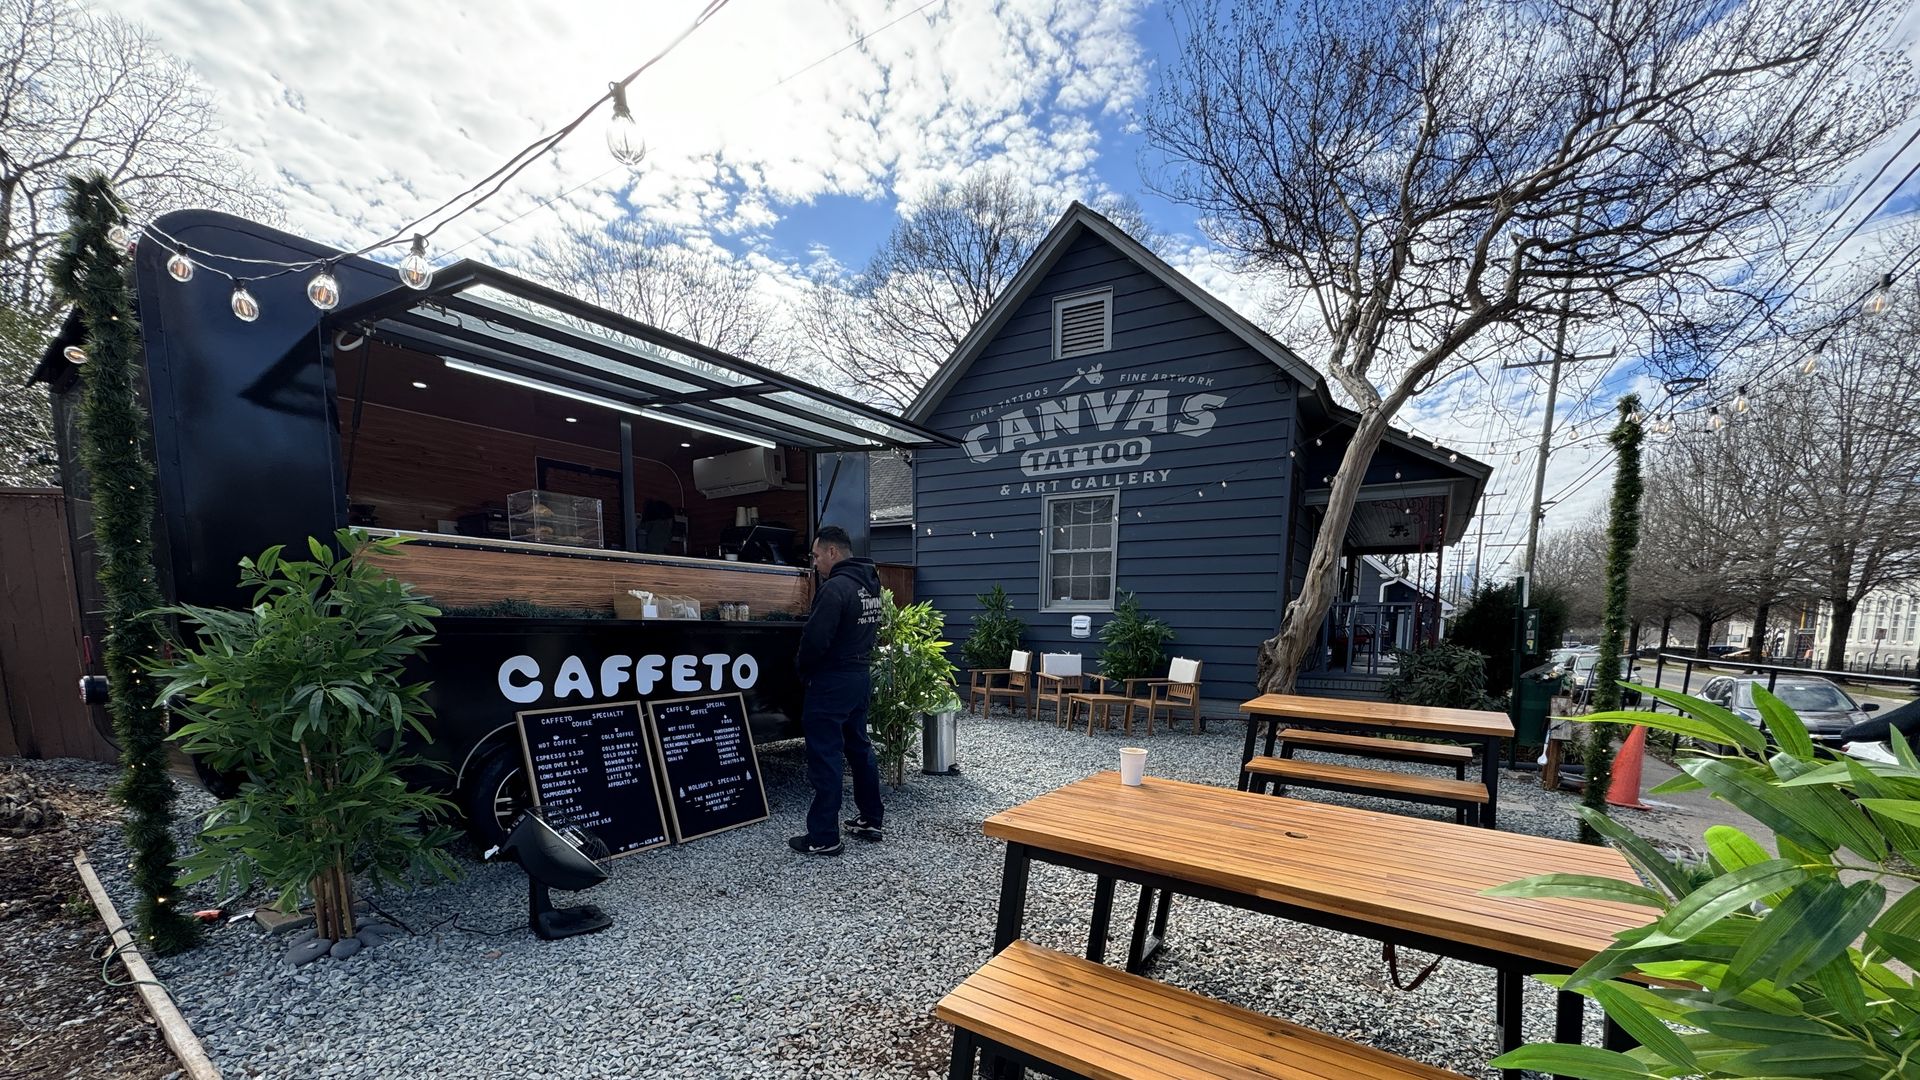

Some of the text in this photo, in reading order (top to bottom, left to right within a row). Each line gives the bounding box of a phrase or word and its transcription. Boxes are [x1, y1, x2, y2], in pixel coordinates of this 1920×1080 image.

[1120, 373, 1215, 387] FINE ARTWORK
[970, 387, 1049, 422] FINE TATTOOS
[960, 389, 1228, 464] CANVAS
[1027, 440, 1145, 472] TATTOO
[1000, 469, 1171, 496] & ART GALLERY
[498, 653, 759, 704] CAFFETO
[706, 701, 726, 709] SPECIAL
[690, 708, 708, 716] COFFEE
[541, 710, 624, 728] CAFFETO SPECIALTY COFFEE
[672, 732, 695, 740] CHOCOLATE
[553, 739, 577, 747] COFFEE
[536, 752, 566, 762] ESPRESSO
[553, 761, 568, 769] OVER
[605, 764, 633, 774] SHAKERATO
[555, 770, 572, 778] BLACK
[606, 772, 623, 781] LATTE
[541, 780, 567, 790] CORTADO
[608, 778, 631, 788] AFFOGATO
[717, 775, 741, 785] SPECIALS
[543, 788, 573, 799] CAPPUCCINO
